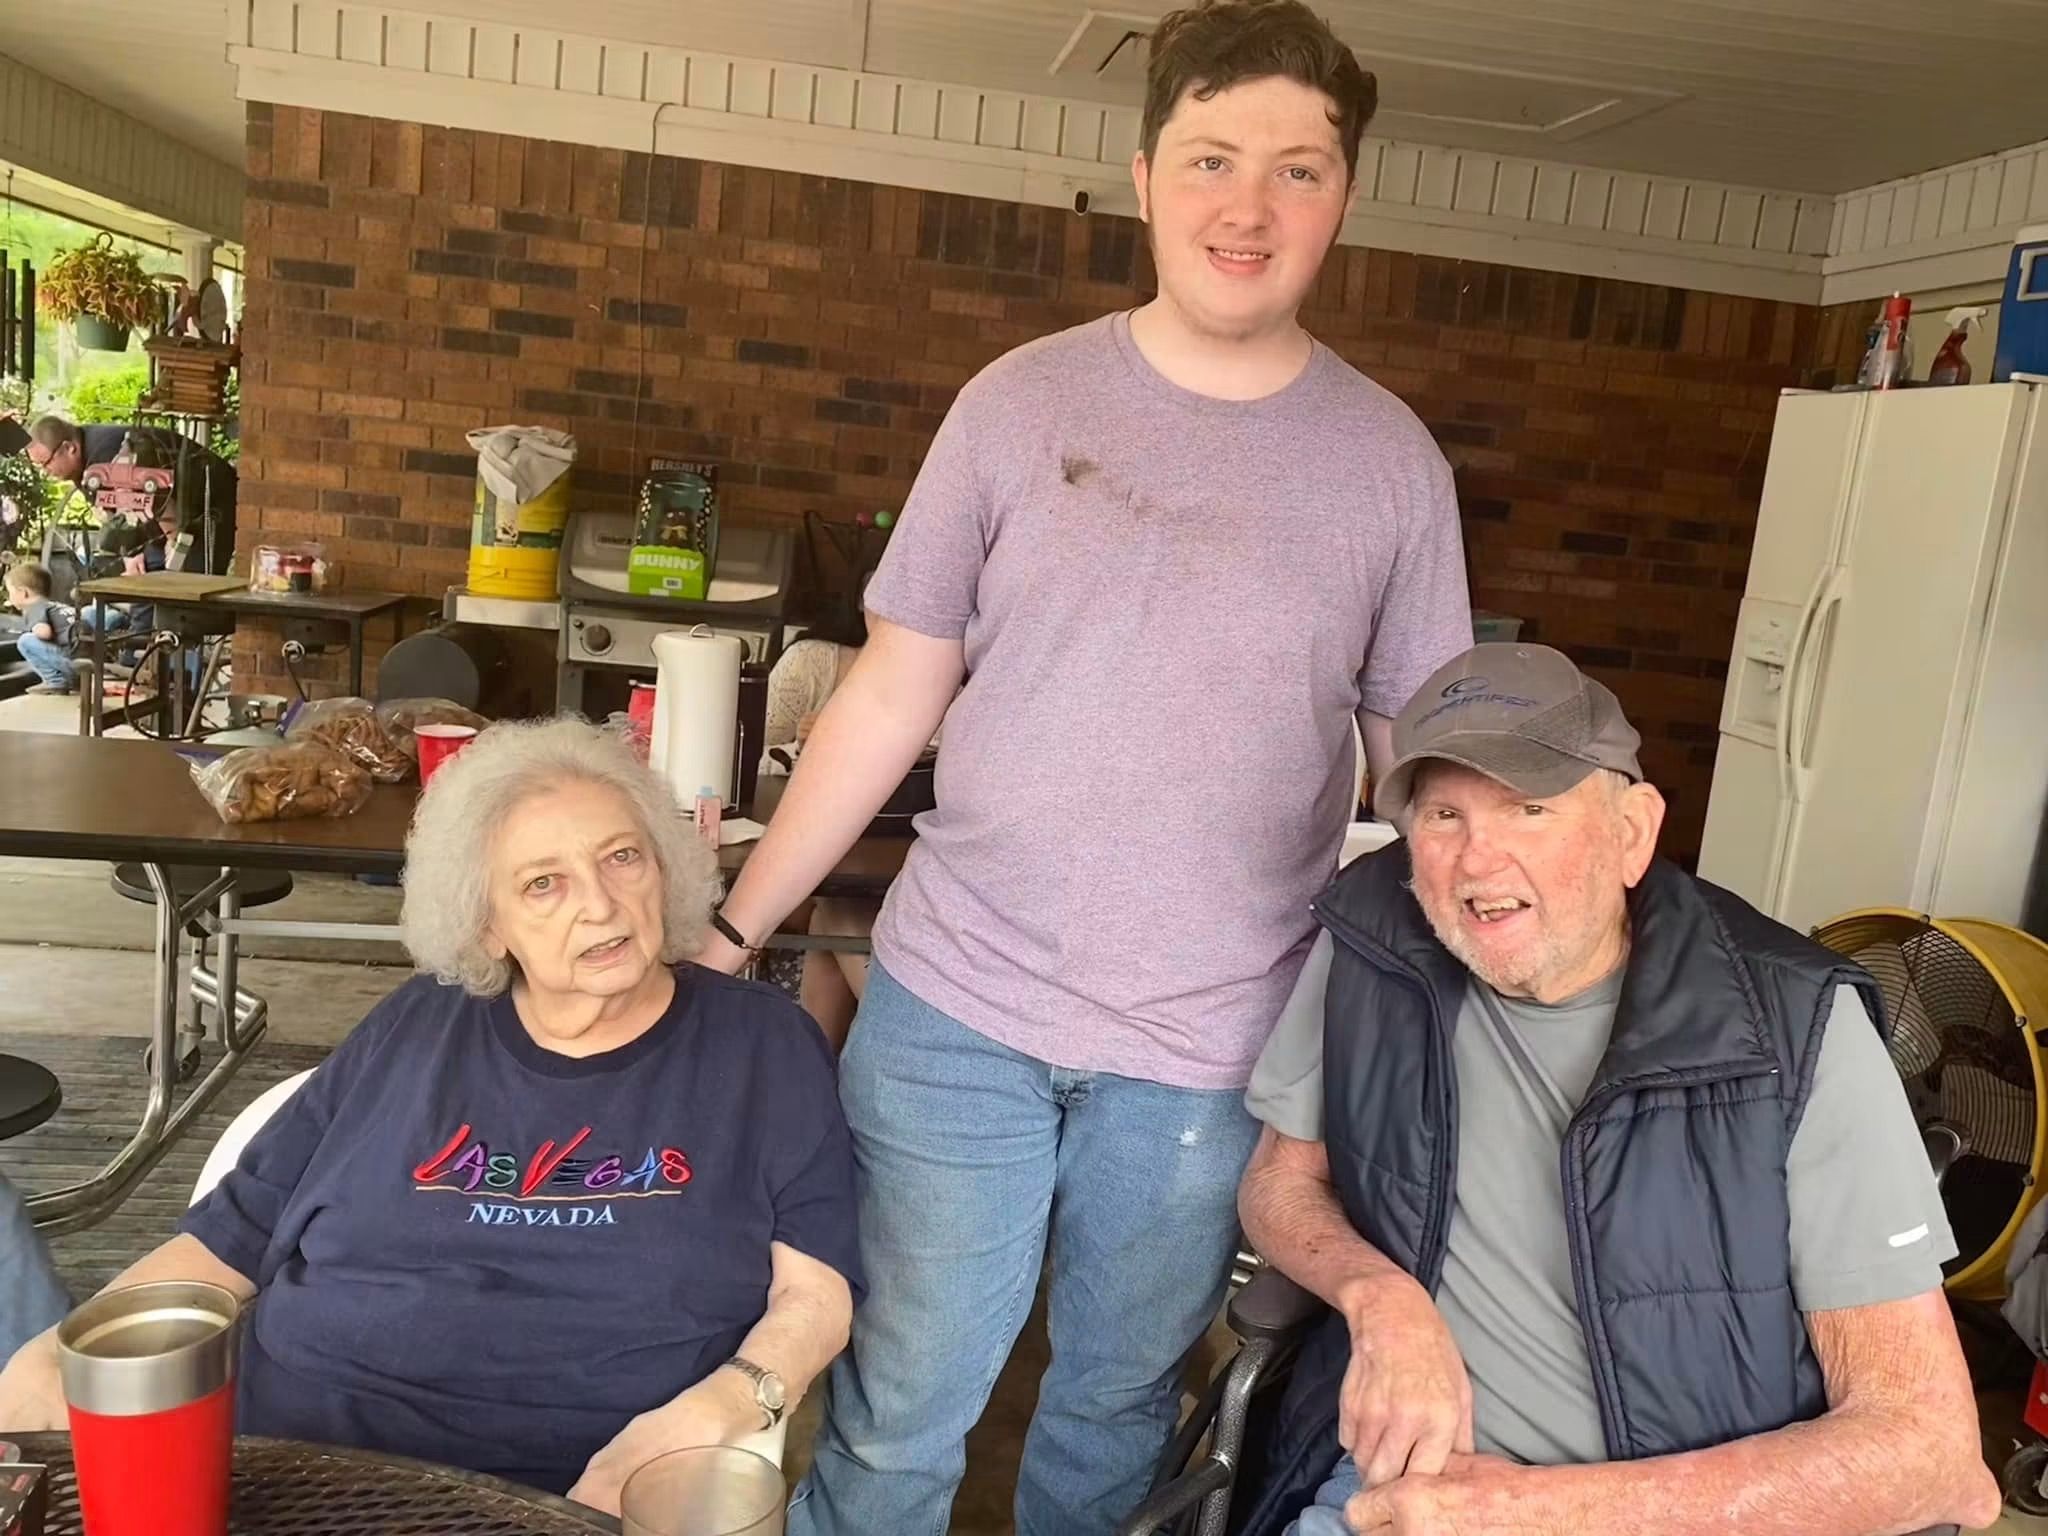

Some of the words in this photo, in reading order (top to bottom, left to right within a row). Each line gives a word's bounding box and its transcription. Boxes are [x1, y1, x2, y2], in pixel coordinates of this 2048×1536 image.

[98, 493, 151, 508] WELME
[632, 553, 701, 571] BUNNY
[412, 1122, 518, 1192] LAS
[520, 1126, 693, 1197] VEGAS
[465, 1202, 619, 1227] NEVADA
